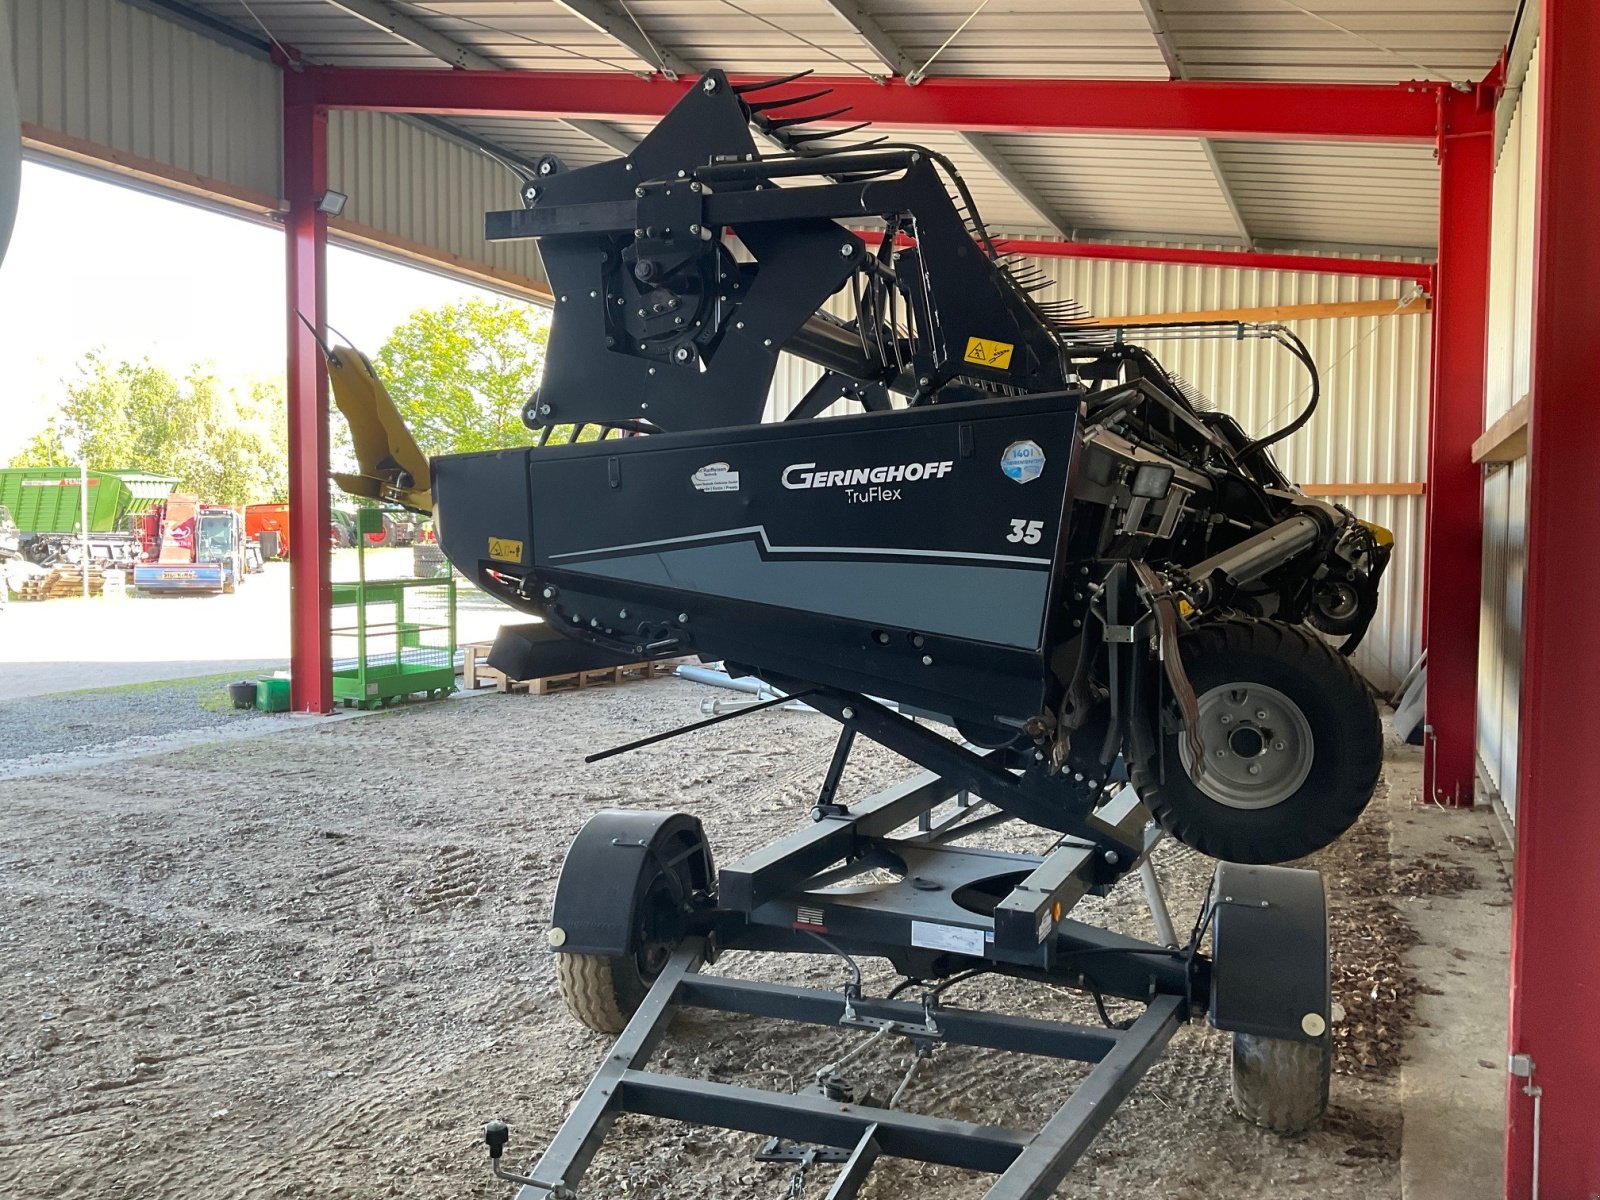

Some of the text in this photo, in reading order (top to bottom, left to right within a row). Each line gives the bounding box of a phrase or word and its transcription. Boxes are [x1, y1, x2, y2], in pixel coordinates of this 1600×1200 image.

[781, 461, 954, 490] GERINGHOFF
[845, 486, 902, 504] TruFlex
[1006, 518, 1044, 545] 35
